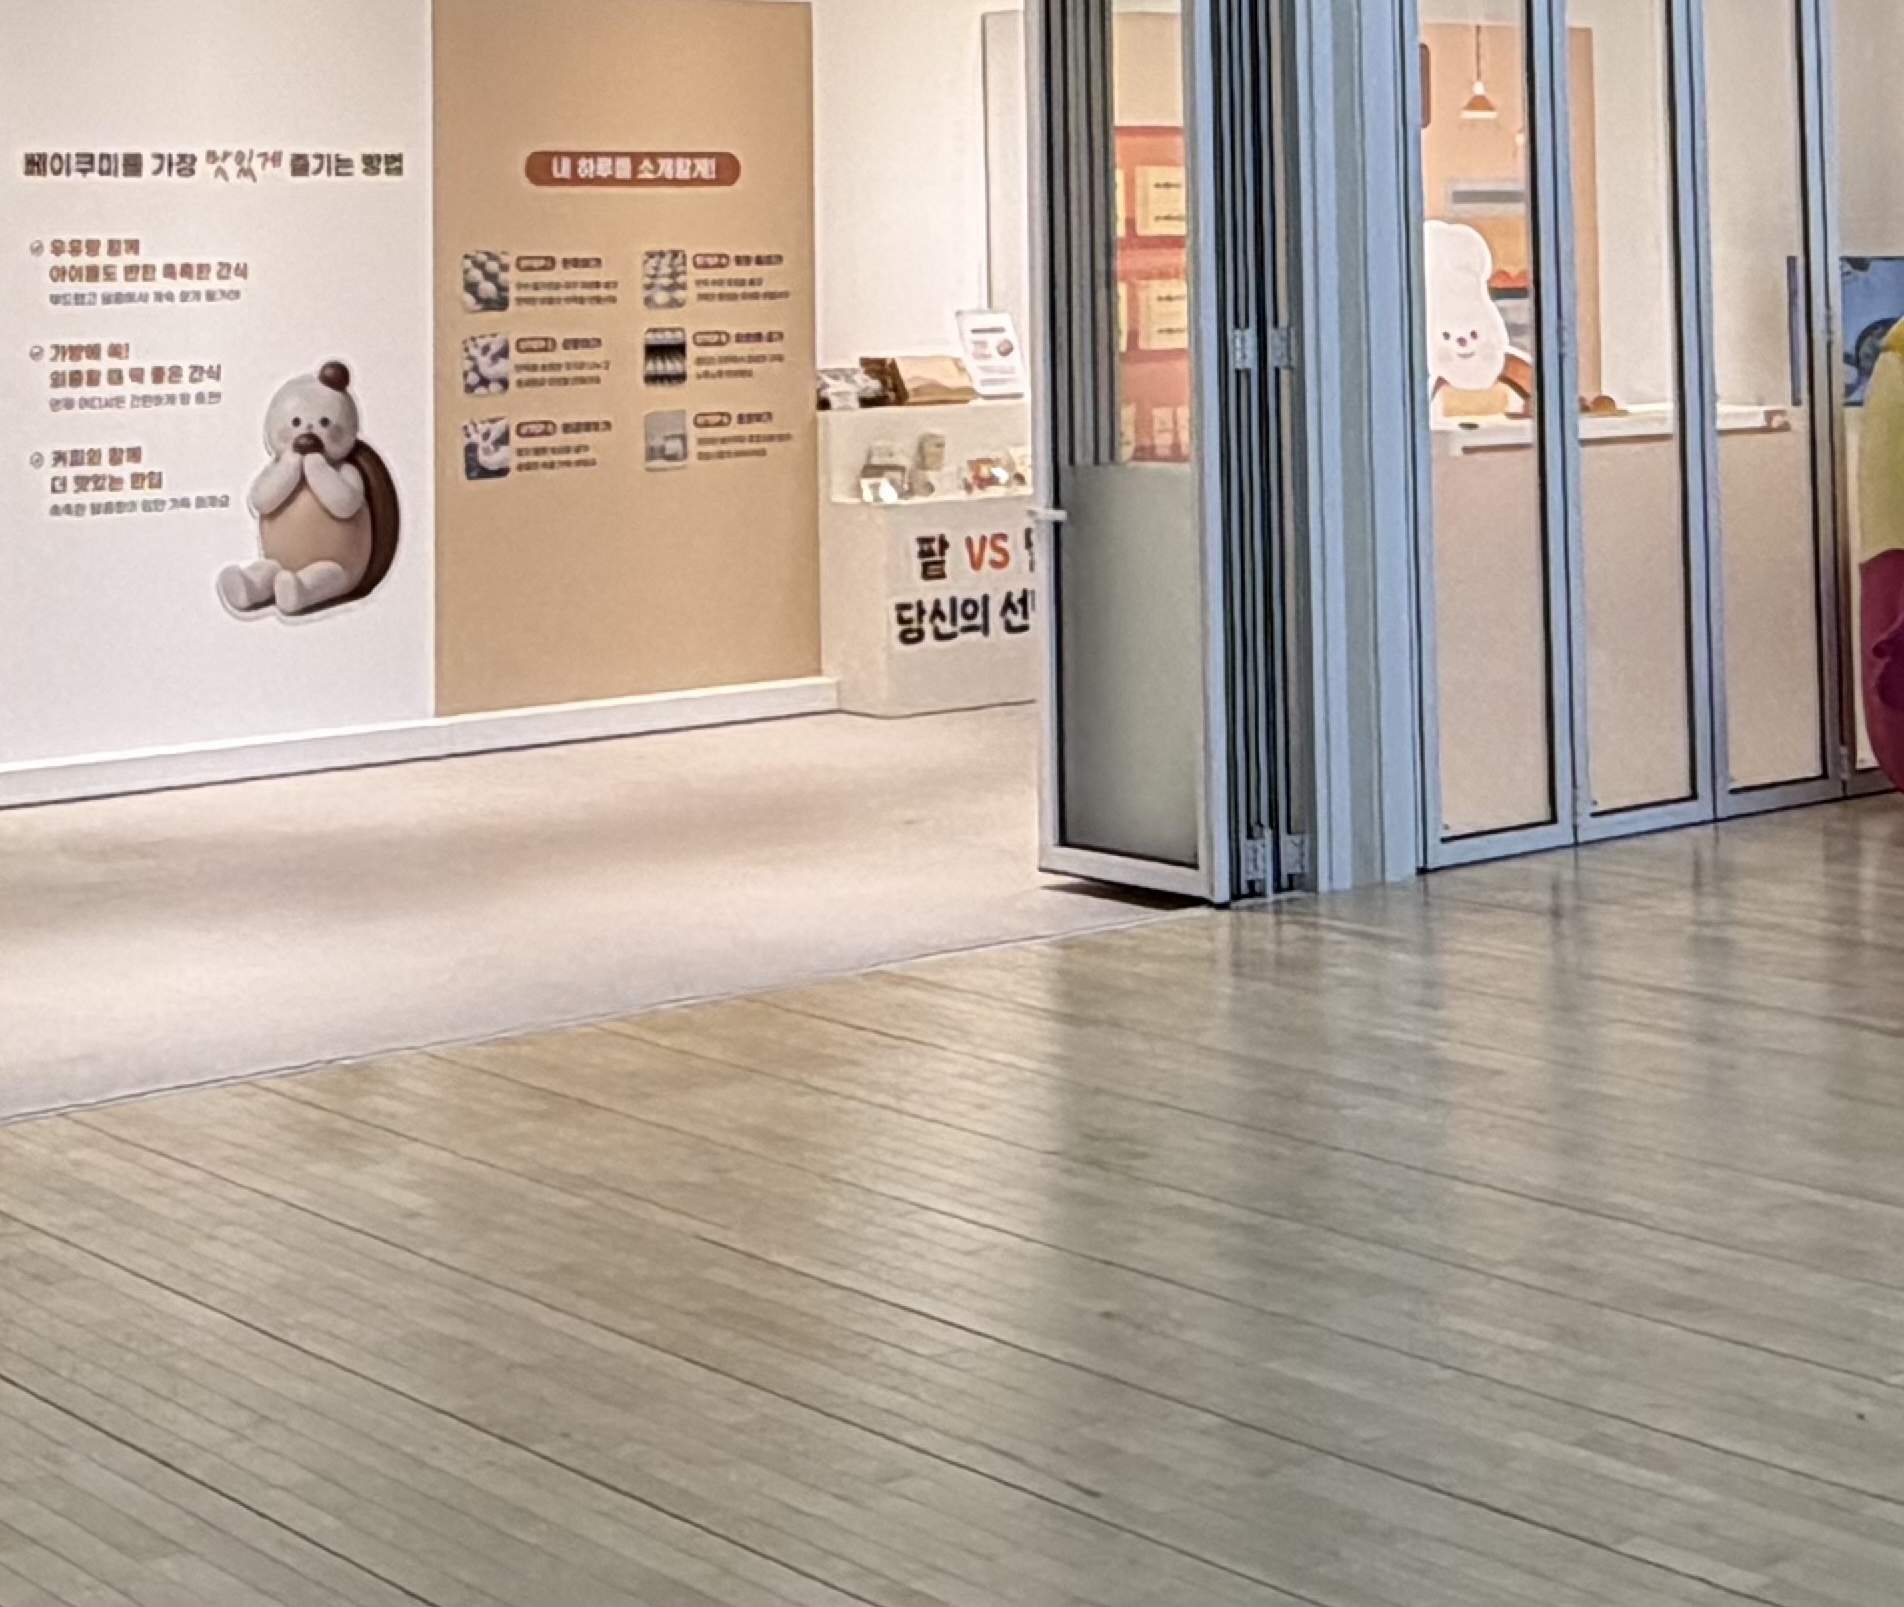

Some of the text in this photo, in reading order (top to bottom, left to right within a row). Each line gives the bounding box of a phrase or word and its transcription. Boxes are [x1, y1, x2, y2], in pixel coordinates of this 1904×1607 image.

[23, 149, 404, 182] 베이쿠미를 가장 맛있게 즐기는 방법
[552, 156, 571, 178] 내
[637, 157, 716, 180] 소개할게!
[216, 261, 248, 281] 간식
[49, 343, 102, 362] 가방에
[188, 363, 222, 383] 간식
[50, 475, 67, 494] 더
[965, 532, 1010, 571] VS
[895, 587, 1035, 645] 당신의 선
